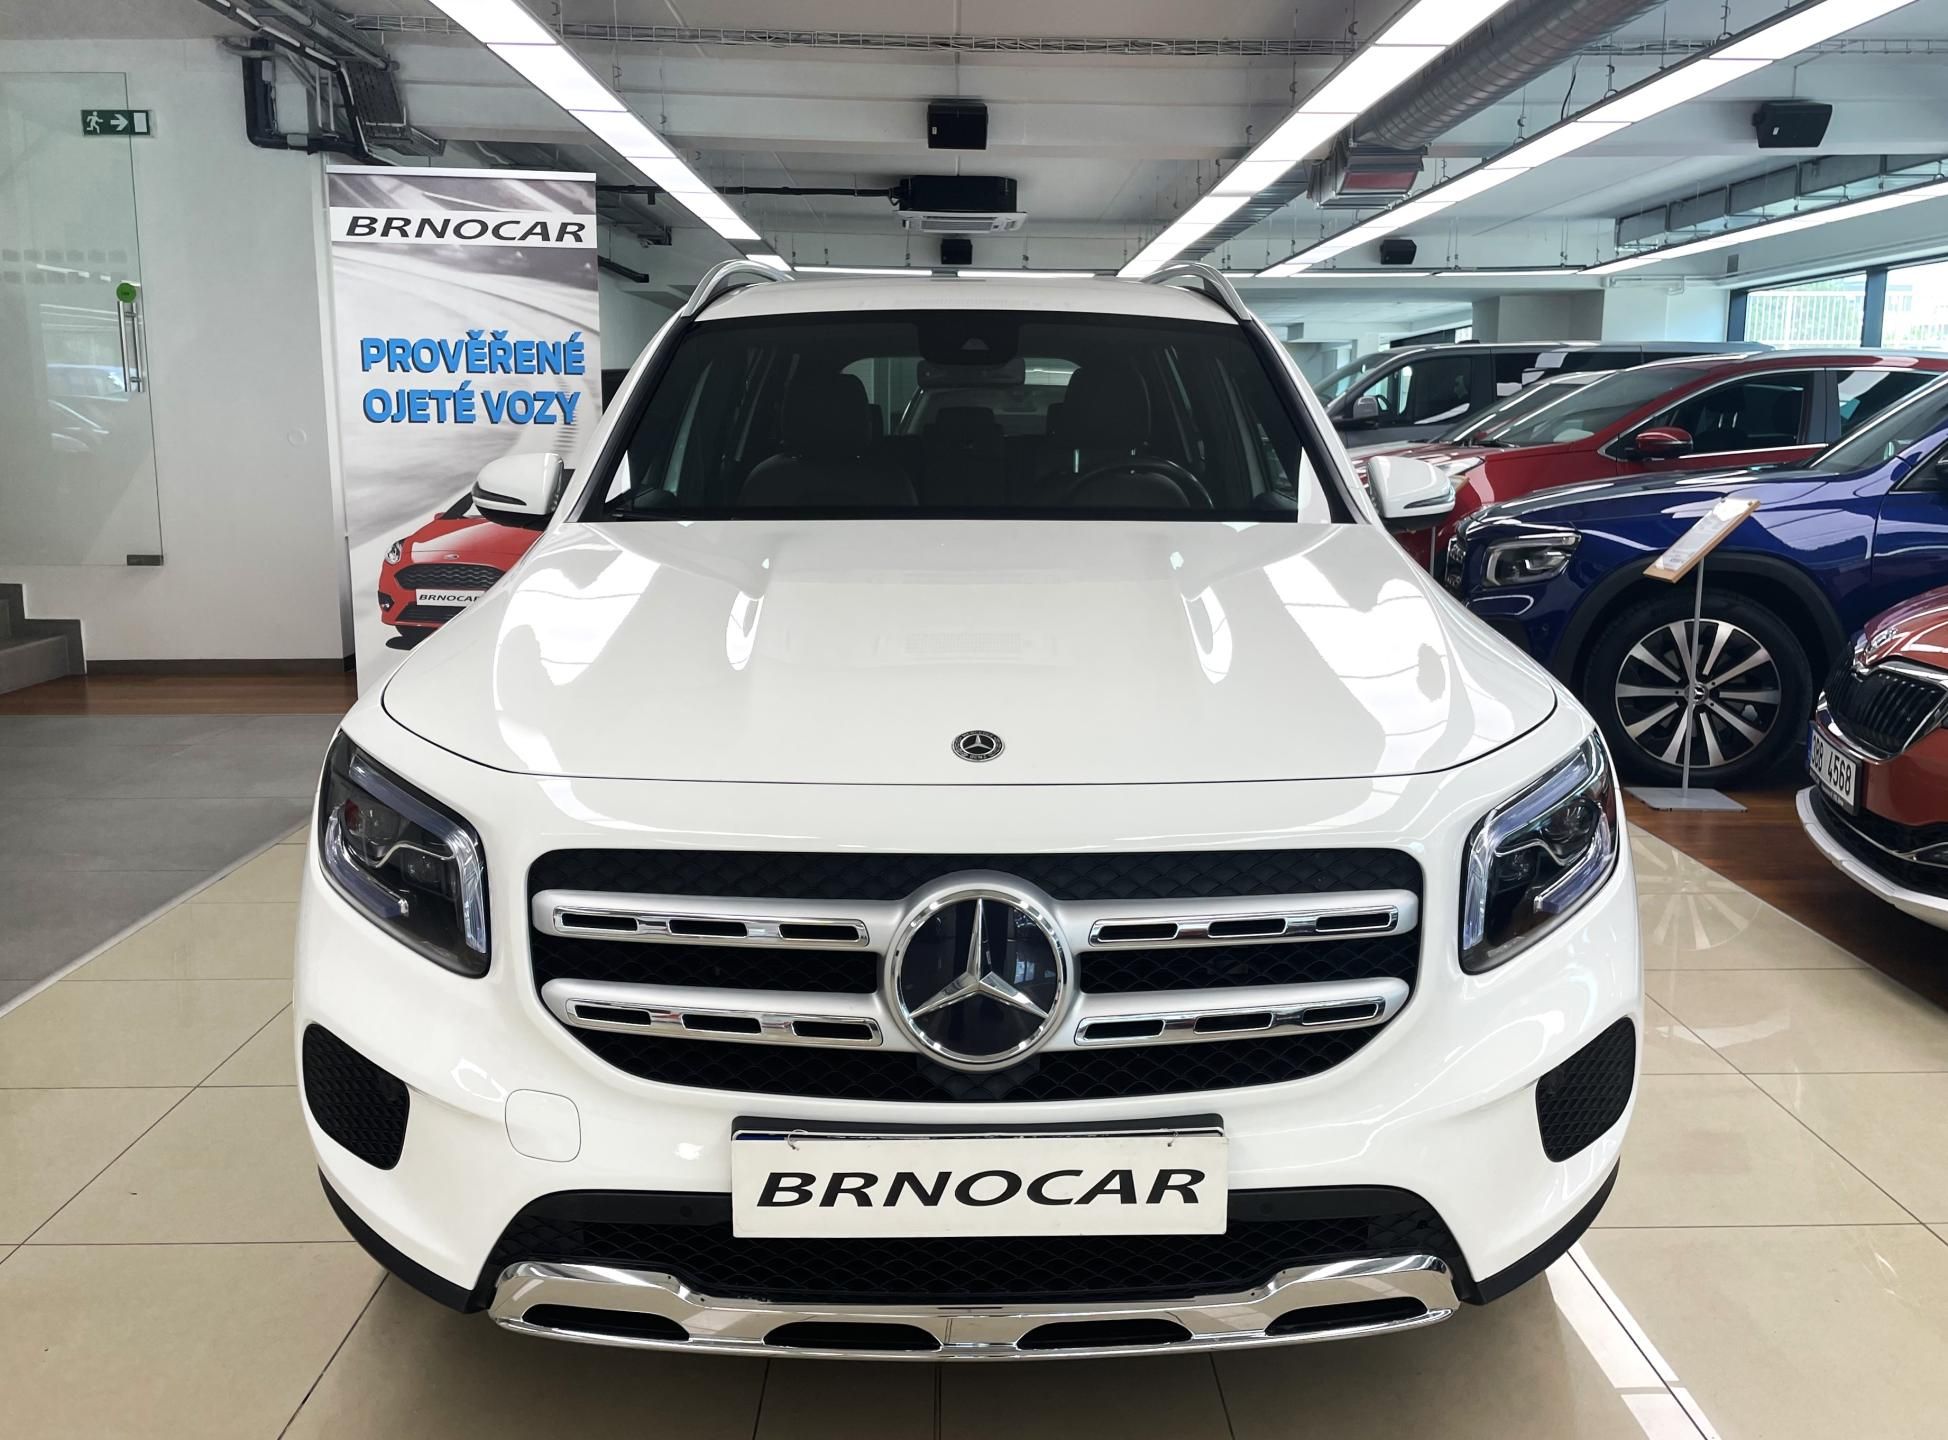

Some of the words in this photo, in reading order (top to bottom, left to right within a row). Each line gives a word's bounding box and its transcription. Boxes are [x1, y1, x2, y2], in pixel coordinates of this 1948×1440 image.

[346, 215, 586, 243] BRNOCAR
[360, 329, 586, 376] PROVĚŘENÉ
[362, 380, 477, 424] OJETÉ
[482, 390, 581, 425] VOZY
[1828, 751, 1852, 797] 4568
[756, 1169, 1206, 1208] BRNOCAR
